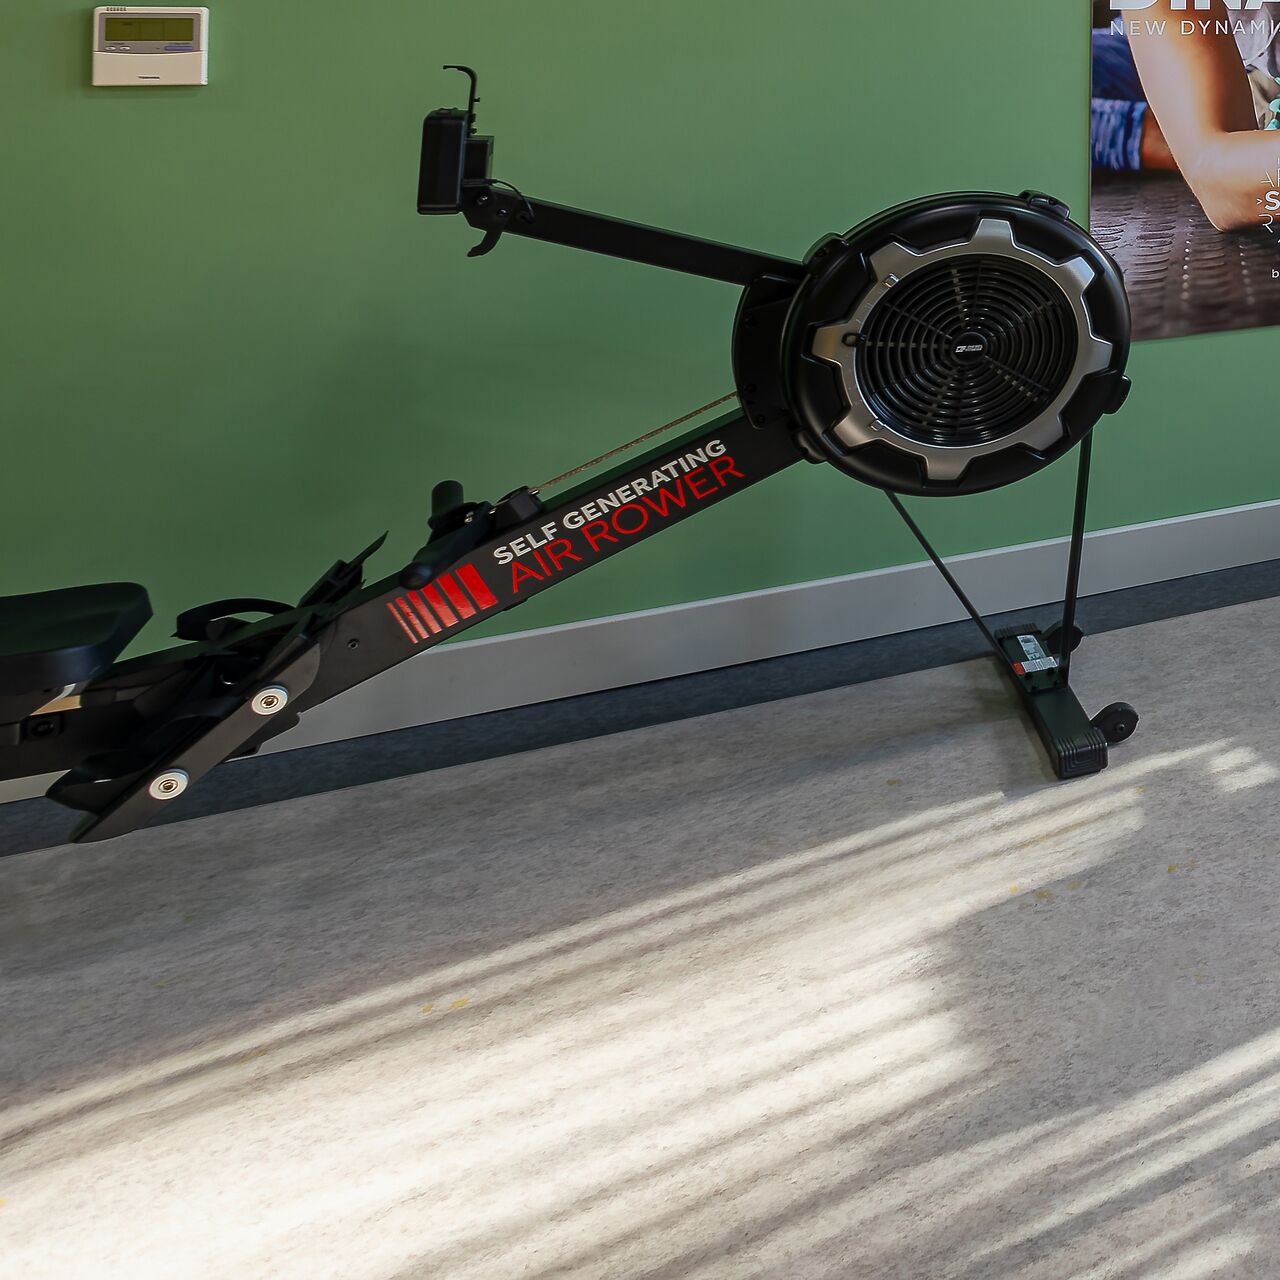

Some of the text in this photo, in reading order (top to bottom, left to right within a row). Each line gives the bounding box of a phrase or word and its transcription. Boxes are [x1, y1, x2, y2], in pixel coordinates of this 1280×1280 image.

[1110, 20, 1166, 36] NEW
[493, 438, 728, 566] SELF GENERATING
[511, 454, 745, 594] AIR ROWER
